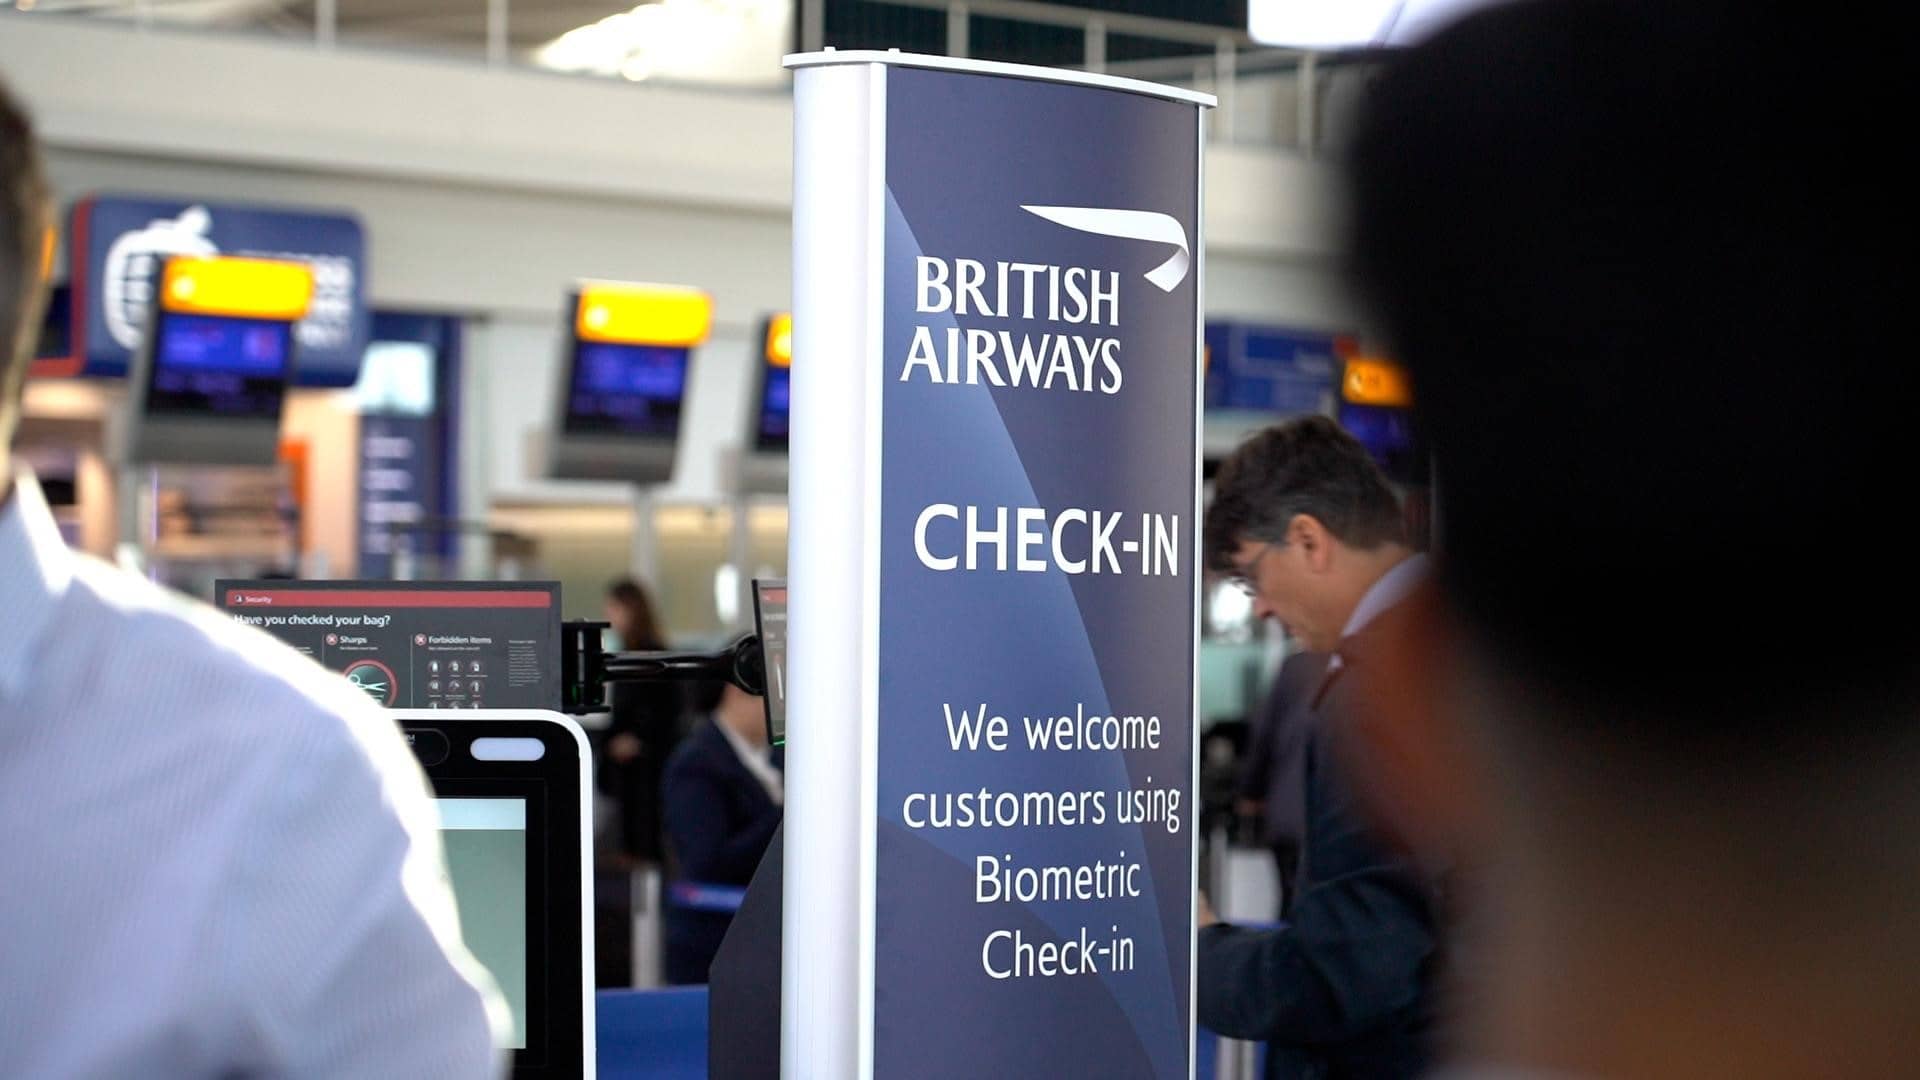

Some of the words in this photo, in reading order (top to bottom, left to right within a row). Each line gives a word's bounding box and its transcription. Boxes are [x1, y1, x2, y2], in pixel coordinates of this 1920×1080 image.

[915, 255, 1120, 327] BRITISH
[899, 325, 1123, 395] AIRWAYS
[913, 503, 1179, 577] CHECK-IN
[234, 614, 262, 625] Have
[264, 616, 286, 627] you
[288, 614, 333, 625] checked
[335, 616, 360, 627] your
[363, 614, 391, 627] bag?
[245, 595, 272, 604] Security
[339, 635, 368, 645] Sharps
[428, 635, 469, 644] Forbidden
[943, 703, 1009, 751] We
[1023, 702, 1161, 751] welcome
[903, 787, 1106, 828] customers
[1117, 775, 1181, 834] using
[976, 850, 1141, 903] Biometric
[982, 925, 1134, 979] Check-in
